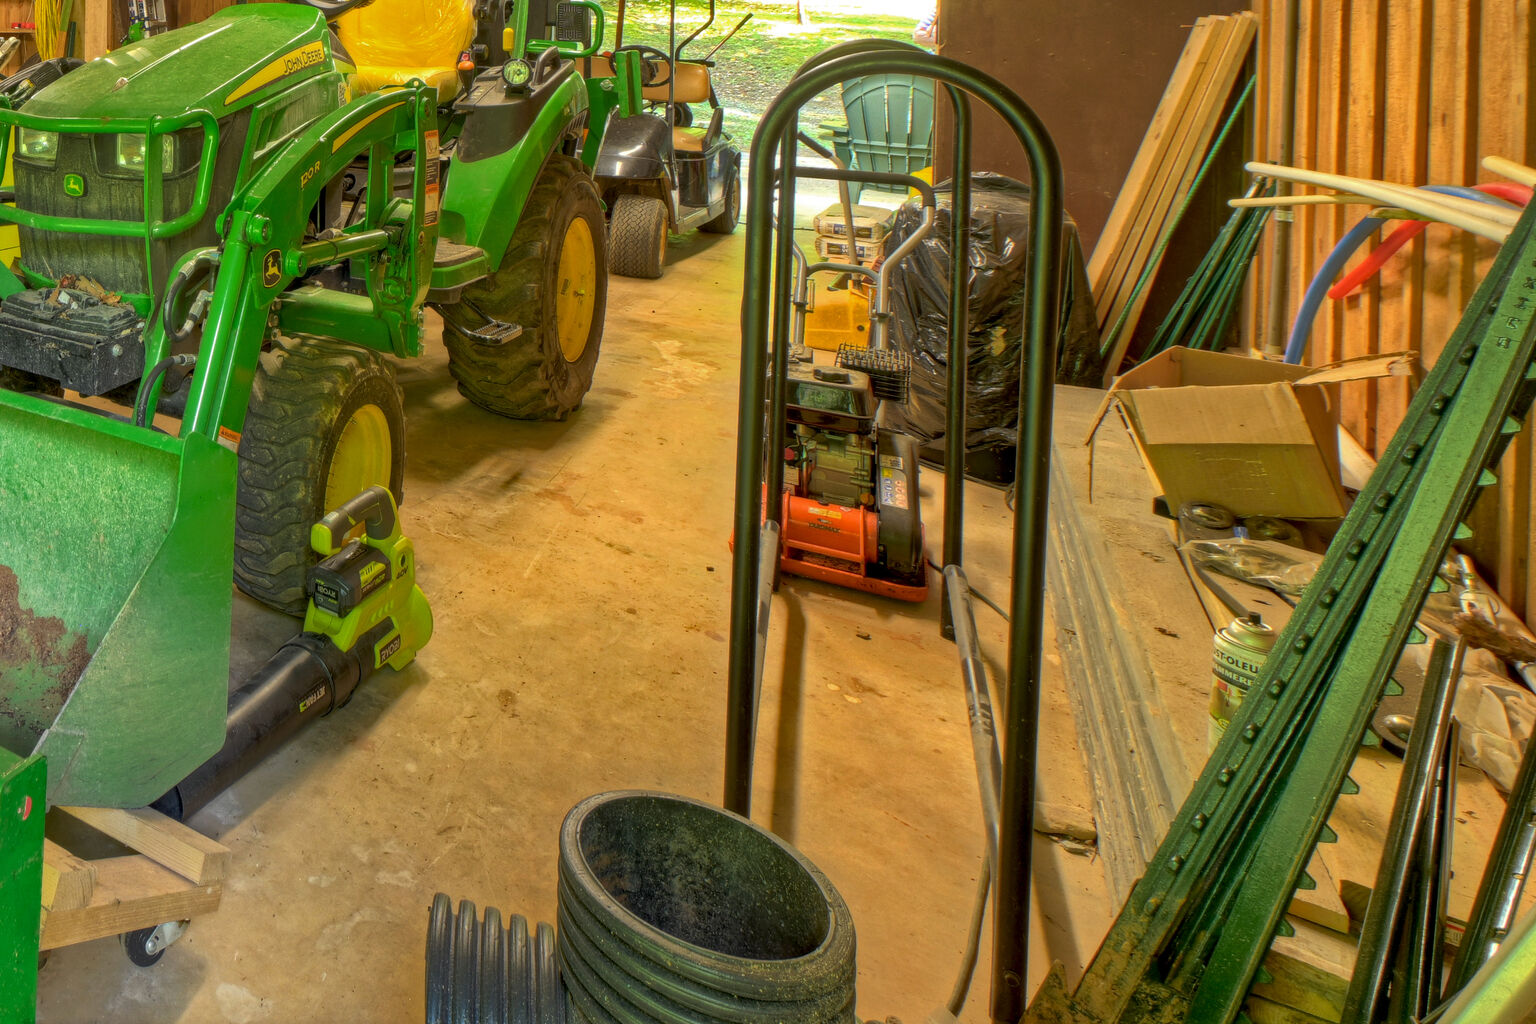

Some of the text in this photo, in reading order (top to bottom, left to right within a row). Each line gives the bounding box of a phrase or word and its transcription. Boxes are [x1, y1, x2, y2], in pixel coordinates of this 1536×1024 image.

[284, 48, 323, 75] JOHN DEERE
[380, 634, 401, 664] RYOBI
[1215, 649, 1259, 674] ST-OLEU
